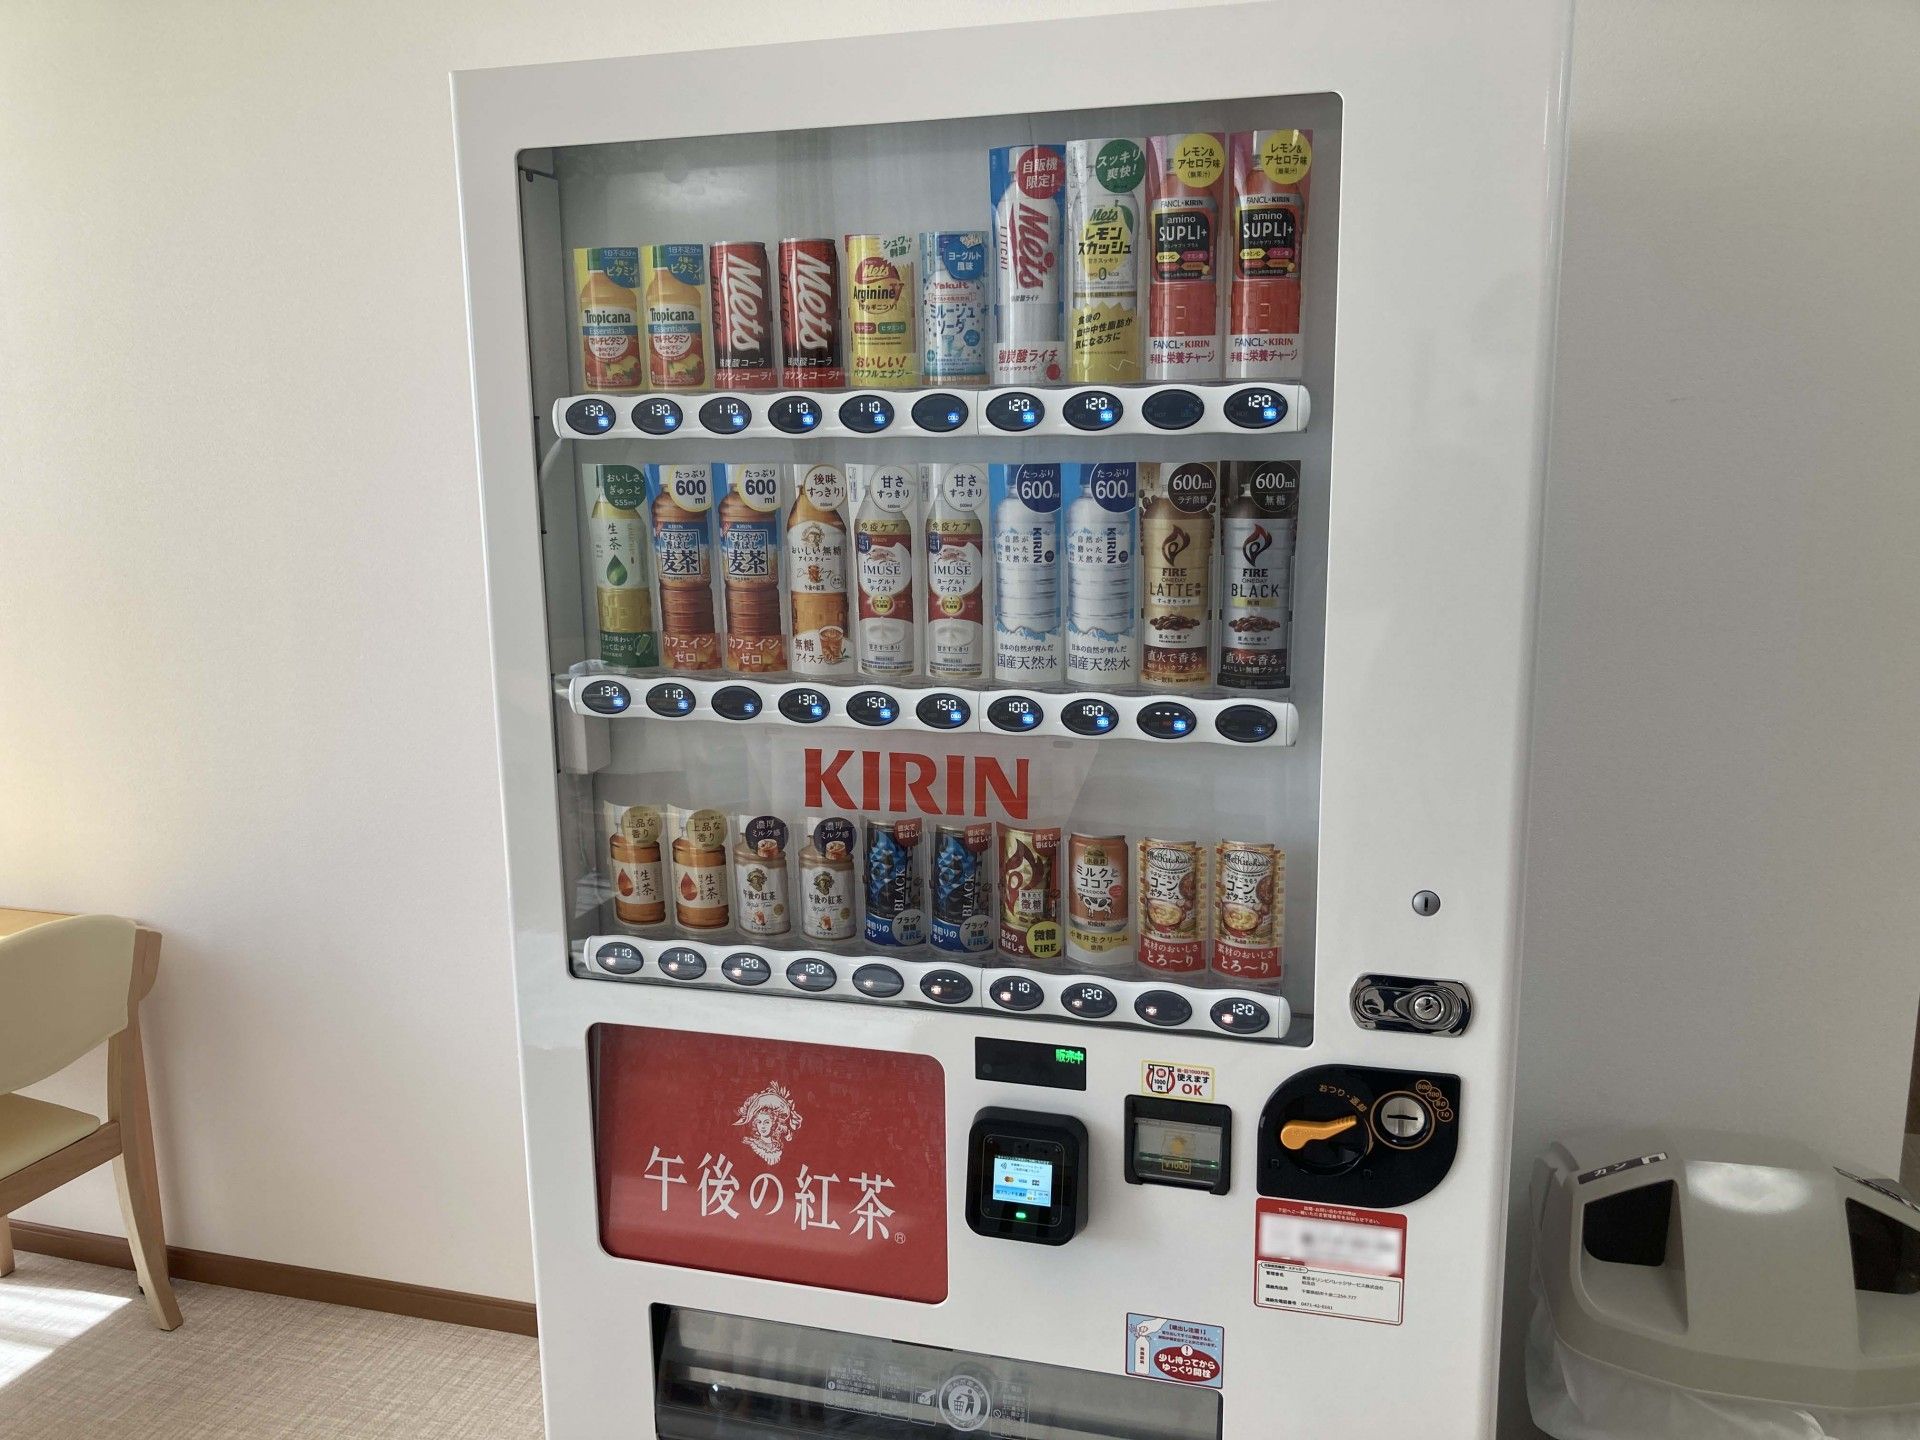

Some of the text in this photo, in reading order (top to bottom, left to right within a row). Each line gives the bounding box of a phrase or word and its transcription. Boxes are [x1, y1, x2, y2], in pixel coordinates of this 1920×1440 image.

[1183, 148, 1215, 157] レモン&
[1271, 143, 1302, 154] レモン&
[1097, 148, 1141, 168] スッキリ
[1178, 157, 1221, 169] アセロラ味
[1265, 155, 1307, 166] アセロラ味
[1023, 158, 1057, 174] 自販機
[1026, 175, 1055, 189] 限定!
[1090, 209, 1118, 222] Mets
[1167, 215, 1196, 224] amino
[1253, 212, 1282, 221] amino
[1085, 227, 1122, 240] レモン
[1078, 241, 1132, 255] スカッシュ
[948, 252, 982, 260] ヨーグルト
[853, 285, 895, 304] Arginine
[649, 308, 695, 323] Tropicana
[930, 303, 976, 319] ミルージュ
[584, 310, 631, 326] Tropicana
[938, 319, 966, 335] ソーダ
[859, 401, 880, 413] 110
[1008, 399, 1030, 412] 120
[1085, 397, 1108, 410] 120
[1248, 394, 1271, 408] 120
[584, 405, 604, 417] 130
[650, 404, 670, 416] 130
[719, 403, 739, 415] 110
[788, 402, 809, 414] 110
[675, 470, 706, 479] たっぷり
[744, 470, 776, 478] たっぷり
[1022, 469, 1054, 478] たっぷり
[1097, 469, 1129, 478] たっぷり
[813, 474, 837, 486] 後味
[881, 475, 904, 488] 甘さ
[954, 474, 977, 487] 甘さ
[609, 485, 641, 496] ぎゅっと
[675, 480, 706, 496] 600
[745, 479, 776, 495] 600
[949, 488, 982, 498] すっきり
[877, 489, 910, 498] すっきり
[694, 496, 706, 504] ml
[764, 496, 776, 504] ml
[861, 523, 899, 532] 免疫ケア
[931, 523, 971, 532] 免疫ケア
[1032, 527, 1042, 563] KIRIN
[1106, 527, 1117, 564] KIRIN
[662, 550, 698, 573] 麦茶
[729, 550, 766, 573] 麦茶
[934, 561, 972, 575] iMUSE
[1162, 568, 1188, 577] FIRE
[1243, 568, 1268, 578] FIRE
[1231, 583, 1279, 598] BLACK
[663, 634, 713, 649] カフェイン
[728, 634, 779, 651] カフェイン
[674, 651, 697, 663] ゼロ
[739, 653, 762, 665] ゼロ
[997, 654, 1058, 670] 国産天然水
[1068, 654, 1130, 671] 国産天然水
[600, 686, 619, 697] 130
[664, 689, 683, 700] 110
[798, 694, 817, 705] 130
[866, 697, 886, 708] 150
[936, 700, 957, 711] 150
[1008, 702, 1029, 713] 100
[1082, 705, 1104, 716] 100
[804, 748, 1029, 820] KIRIN
[1076, 865, 1120, 878] ミルクと
[895, 866, 905, 911] BLACK
[1080, 877, 1113, 888] ココア
[1151, 877, 1178, 891] コーン
[1227, 880, 1255, 894] コーン
[962, 872, 975, 918] BLACK
[1150, 888, 1180, 899] ポタージュ
[1226, 892, 1256, 904] ポタージュ
[897, 915, 921, 924] ブラック
[964, 920, 989, 930] ブラック
[1034, 929, 1056, 941] 微糖
[1034, 943, 1057, 953] FIRE
[676, 953, 695, 963] 110
[739, 958, 759, 969] 120
[805, 963, 825, 974] 120
[1010, 982, 1030, 993] 110
[1082, 988, 1103, 1000] 120
[1232, 1004, 1255, 1016] 120
[1055, 1049, 1083, 1064] 販売中
[1177, 1073, 1210, 1084] 使えます
[1182, 1083, 1203, 1096] OK
[643, 1145, 896, 1241] 午後の紅茶
[1158, 1353, 1216, 1370] 少し待ってから
